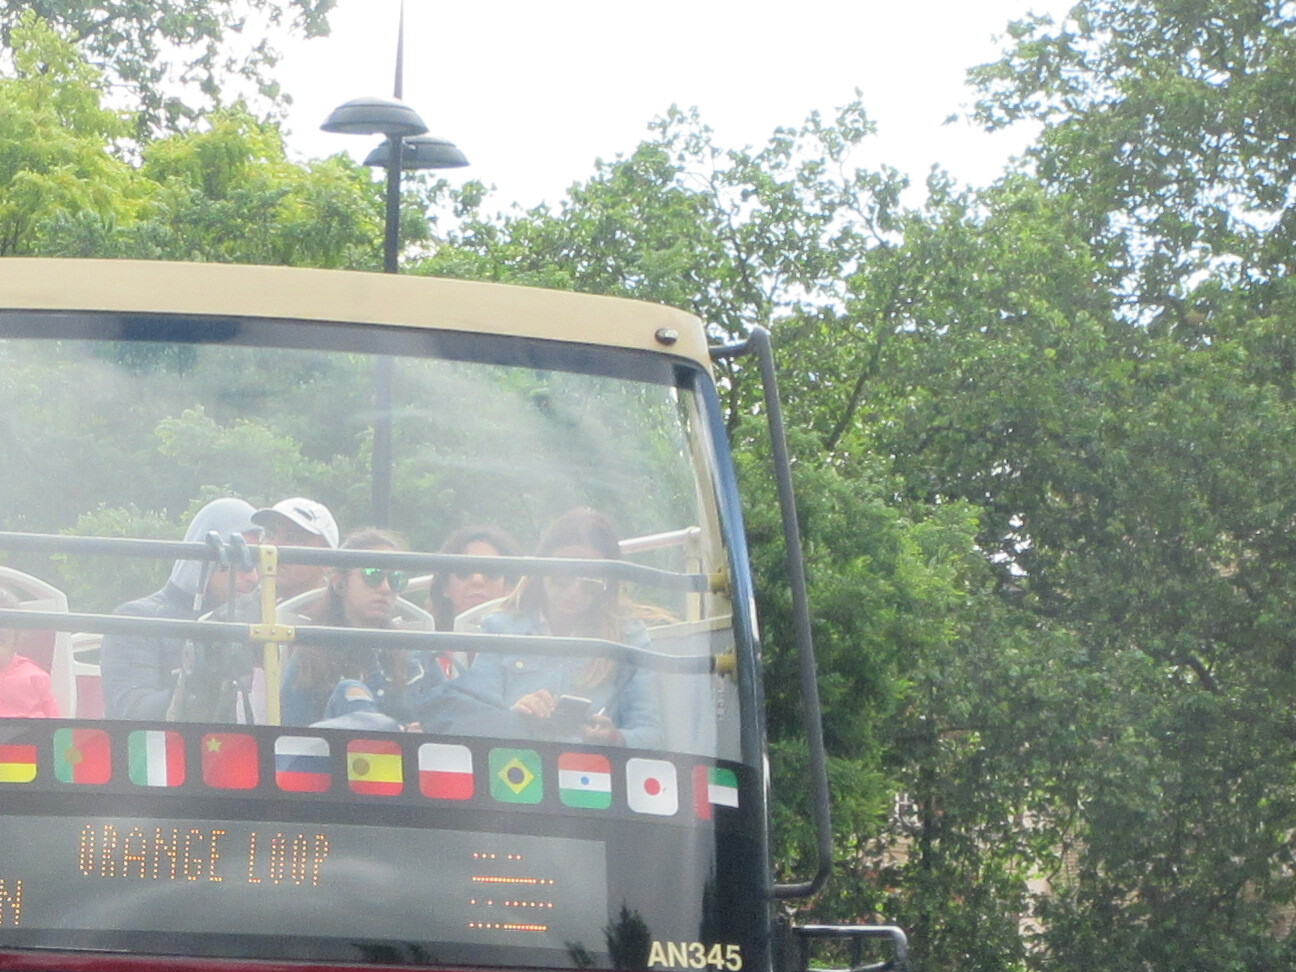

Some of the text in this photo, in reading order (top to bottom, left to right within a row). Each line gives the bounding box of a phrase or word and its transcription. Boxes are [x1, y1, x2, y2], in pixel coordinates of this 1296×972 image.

[79, 823, 330, 887] ORANGE LOOP
[647, 941, 744, 972] AN345
